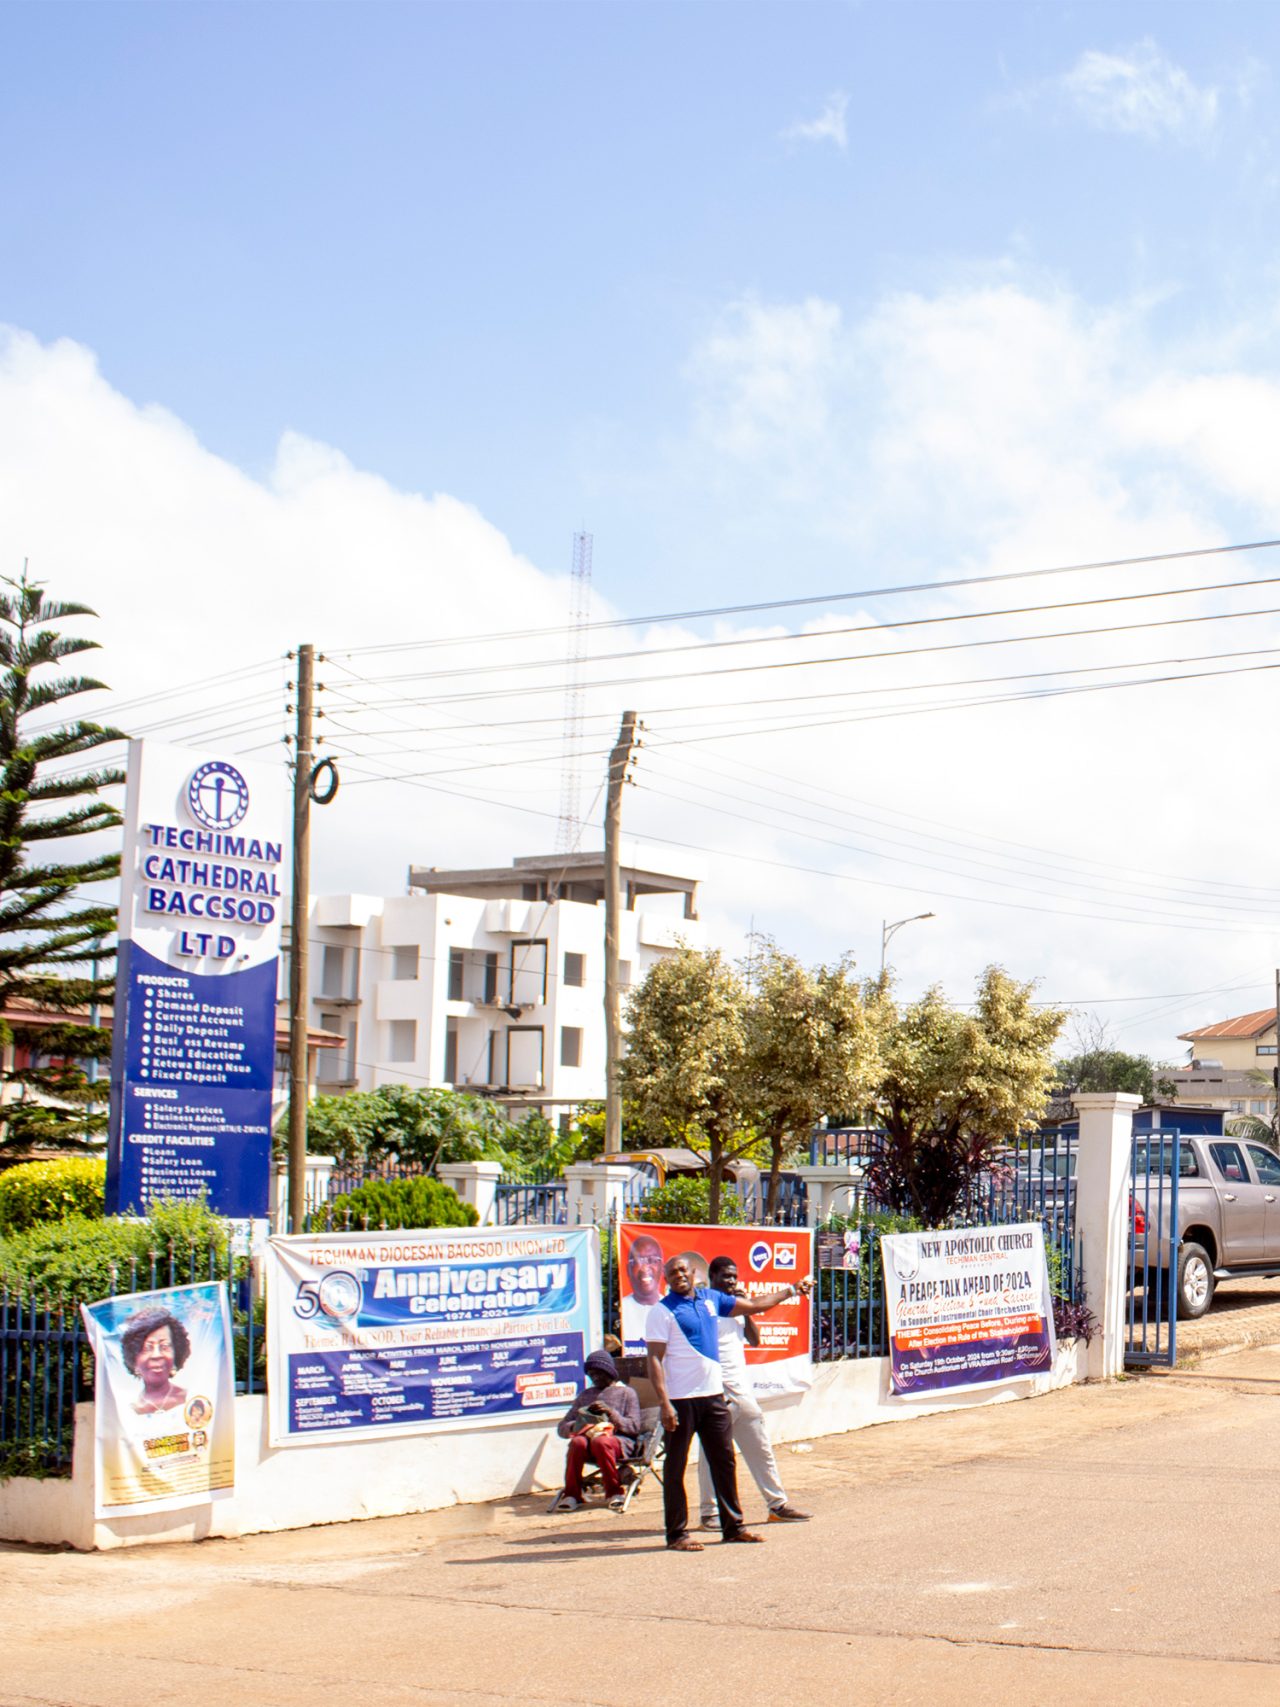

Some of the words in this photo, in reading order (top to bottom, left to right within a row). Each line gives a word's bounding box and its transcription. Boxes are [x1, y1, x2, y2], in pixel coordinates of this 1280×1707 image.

[150, 824, 282, 863] TECHIMAN
[145, 855, 281, 897] CATHEDRAL
[149, 888, 275, 924] BACCSOD
[137, 974, 189, 988] PRODUCTS
[157, 989, 194, 1000] Shares
[156, 999, 200, 1012] Demand
[202, 1003, 244, 1015] Deposit
[155, 1011, 198, 1022] Current
[200, 1014, 244, 1026] Account
[155, 1022, 184, 1035] Daily
[186, 1025, 228, 1037] Deposit
[204, 1038, 245, 1050] Revamp
[154, 1047, 183, 1057] Child
[188, 1048, 242, 1060] Education
[152, 1058, 192, 1070] Ketewa
[194, 1060, 223, 1071] Biara
[152, 1070, 182, 1080] Fixed
[184, 1071, 227, 1083] Deposit
[134, 1087, 178, 1099] SERVICES
[153, 1104, 183, 1114] Salary
[184, 1104, 223, 1114] Services
[153, 1112, 193, 1122] Business
[195, 1114, 226, 1123] Advice
[128, 1134, 164, 1144] CREDIT
[166, 1134, 216, 1146] FACILITIES
[149, 1148, 176, 1156] Loans
[149, 1156, 179, 1167] Salary
[181, 1158, 202, 1166] Loan
[148, 1168, 188, 1176] Business
[190, 1168, 216, 1177] Loans
[149, 1177, 176, 1185] Micro
[308, 1248, 376, 1265] TECHIMAN
[380, 1244, 444, 1262] DIOCESAN
[447, 1242, 502, 1259] BACCSOD
[506, 1240, 542, 1256] UNION
[921, 1241, 942, 1259] NEW
[944, 1236, 995, 1257] APOSTOLIC
[998, 1233, 1033, 1252] CHURCH
[946, 1256, 978, 1264] TECHIMAN
[980, 1252, 1008, 1261] CENTRAL
[373, 1264, 568, 1299] Anniversary
[900, 1284, 907, 1302] A
[910, 1280, 937, 1302] PEACE
[940, 1278, 960, 1298] TALK
[964, 1274, 990, 1295] AHEAD
[994, 1273, 1004, 1292] OF
[1006, 1270, 1032, 1290] 2024
[410, 1290, 540, 1314] Celebration
[444, 1312, 472, 1320] 1974
[482, 1310, 509, 1318] 2024
[372, 1395, 405, 1406] OCTOBER
